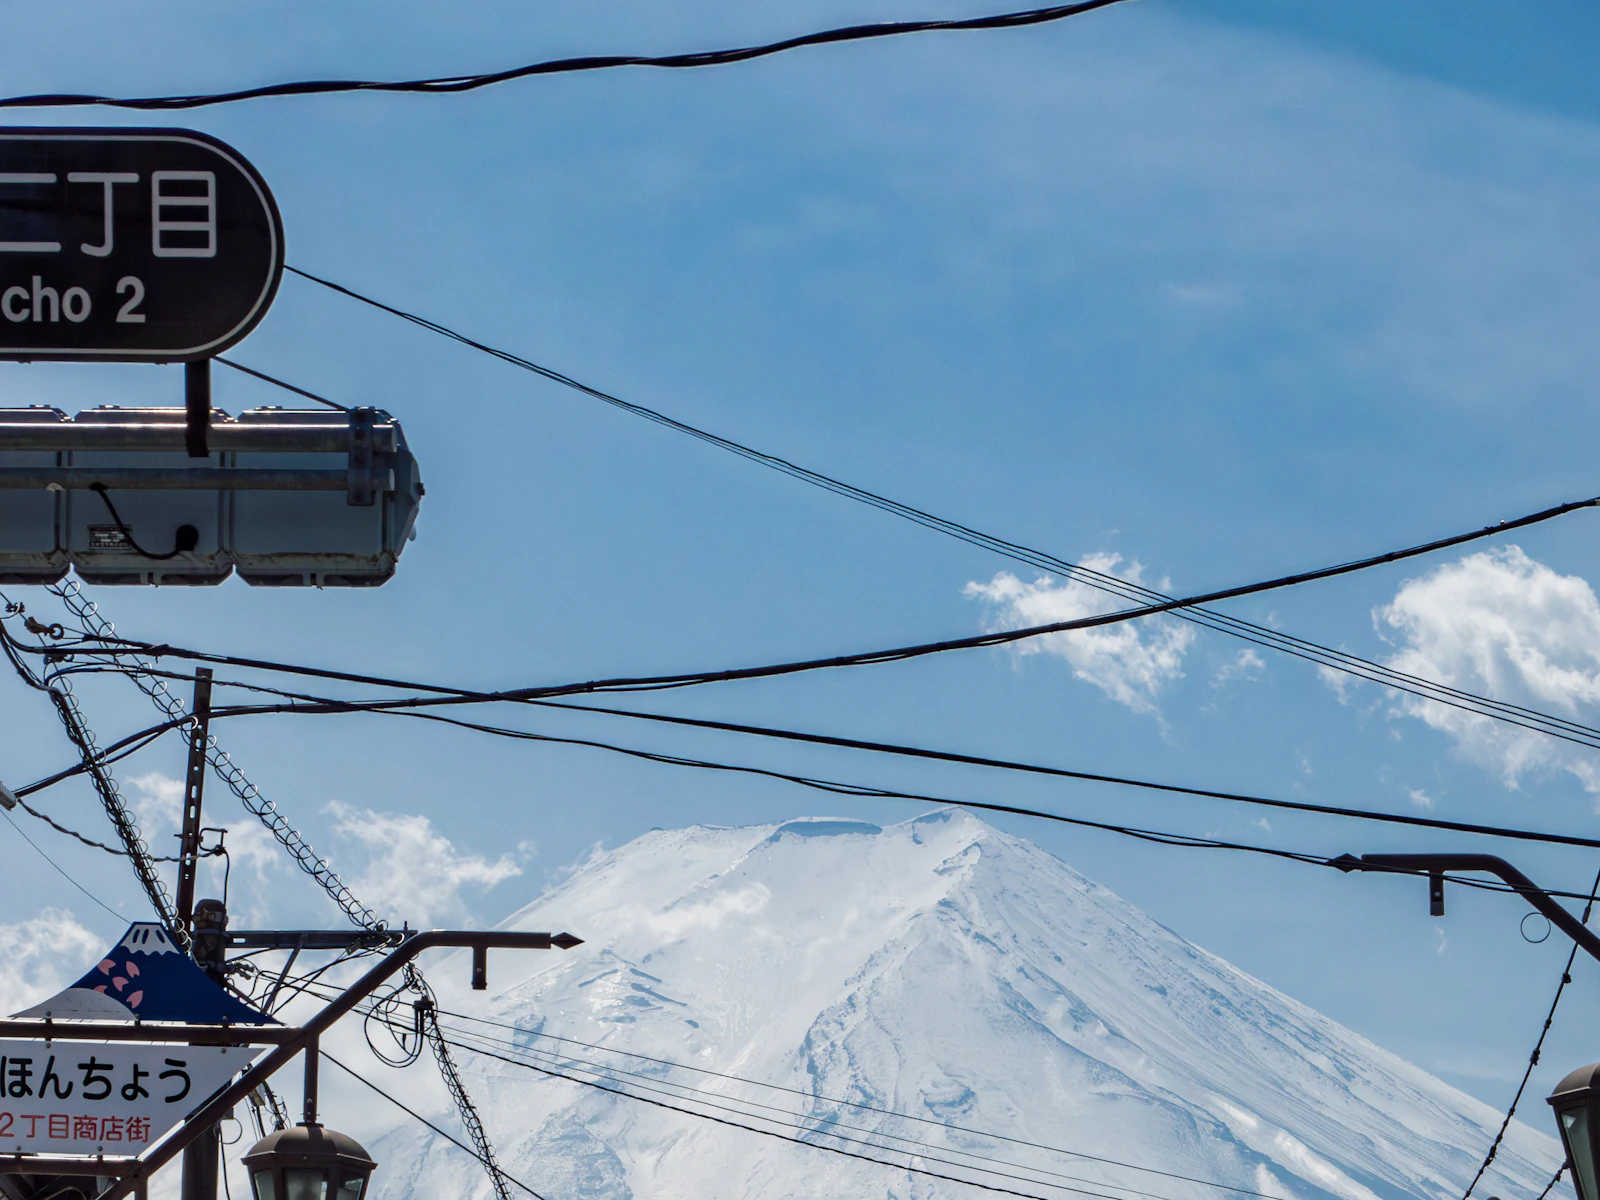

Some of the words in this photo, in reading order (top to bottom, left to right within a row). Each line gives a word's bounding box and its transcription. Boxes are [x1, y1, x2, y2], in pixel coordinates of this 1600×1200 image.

[0, 170, 218, 258] 二丁目
[1, 275, 92, 323] cho
[115, 275, 146, 323] 2
[0, 1055, 192, 1104] ほんちょう
[0, 1111, 152, 1144] 2丁目商店街
